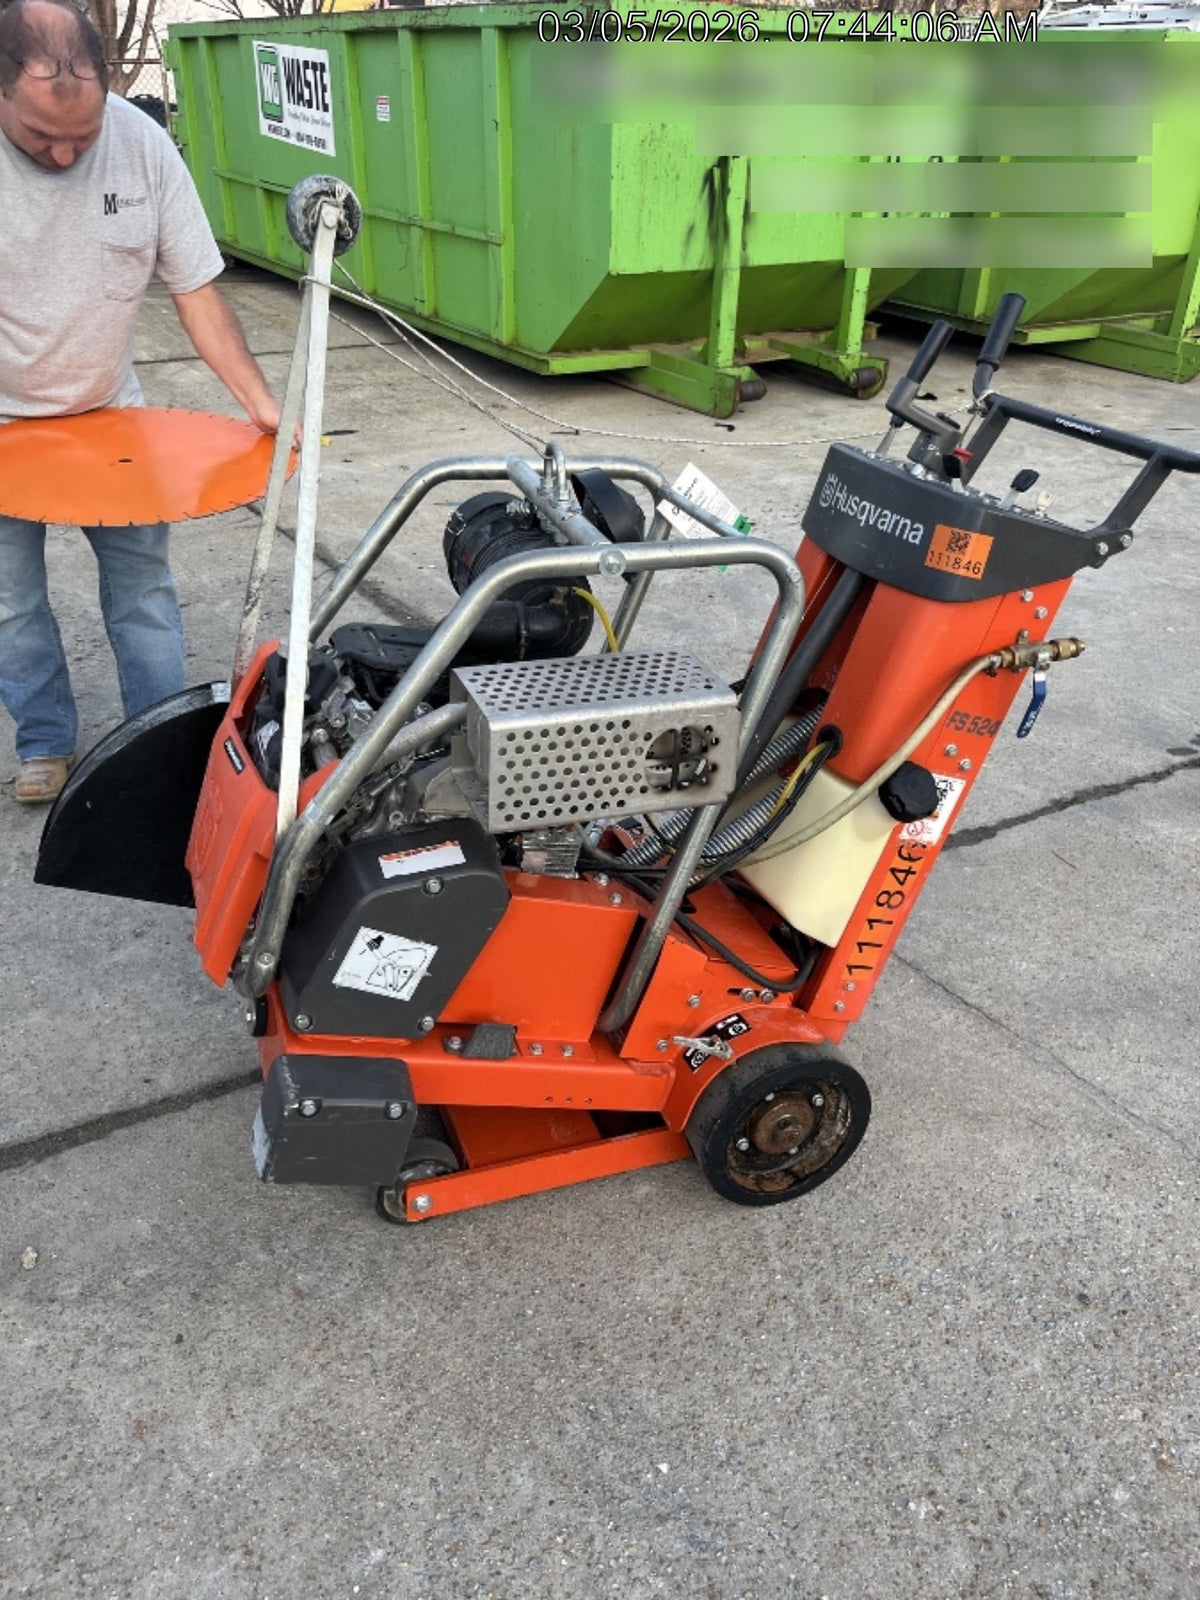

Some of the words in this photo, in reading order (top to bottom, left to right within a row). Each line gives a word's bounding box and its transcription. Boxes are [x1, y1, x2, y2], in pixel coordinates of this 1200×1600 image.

[282, 56, 330, 113] WASTE
[831, 481, 925, 546] Husqvarna
[928, 550, 983, 575] 111846
[947, 711, 971, 732] FS
[967, 715, 1003, 738] 524
